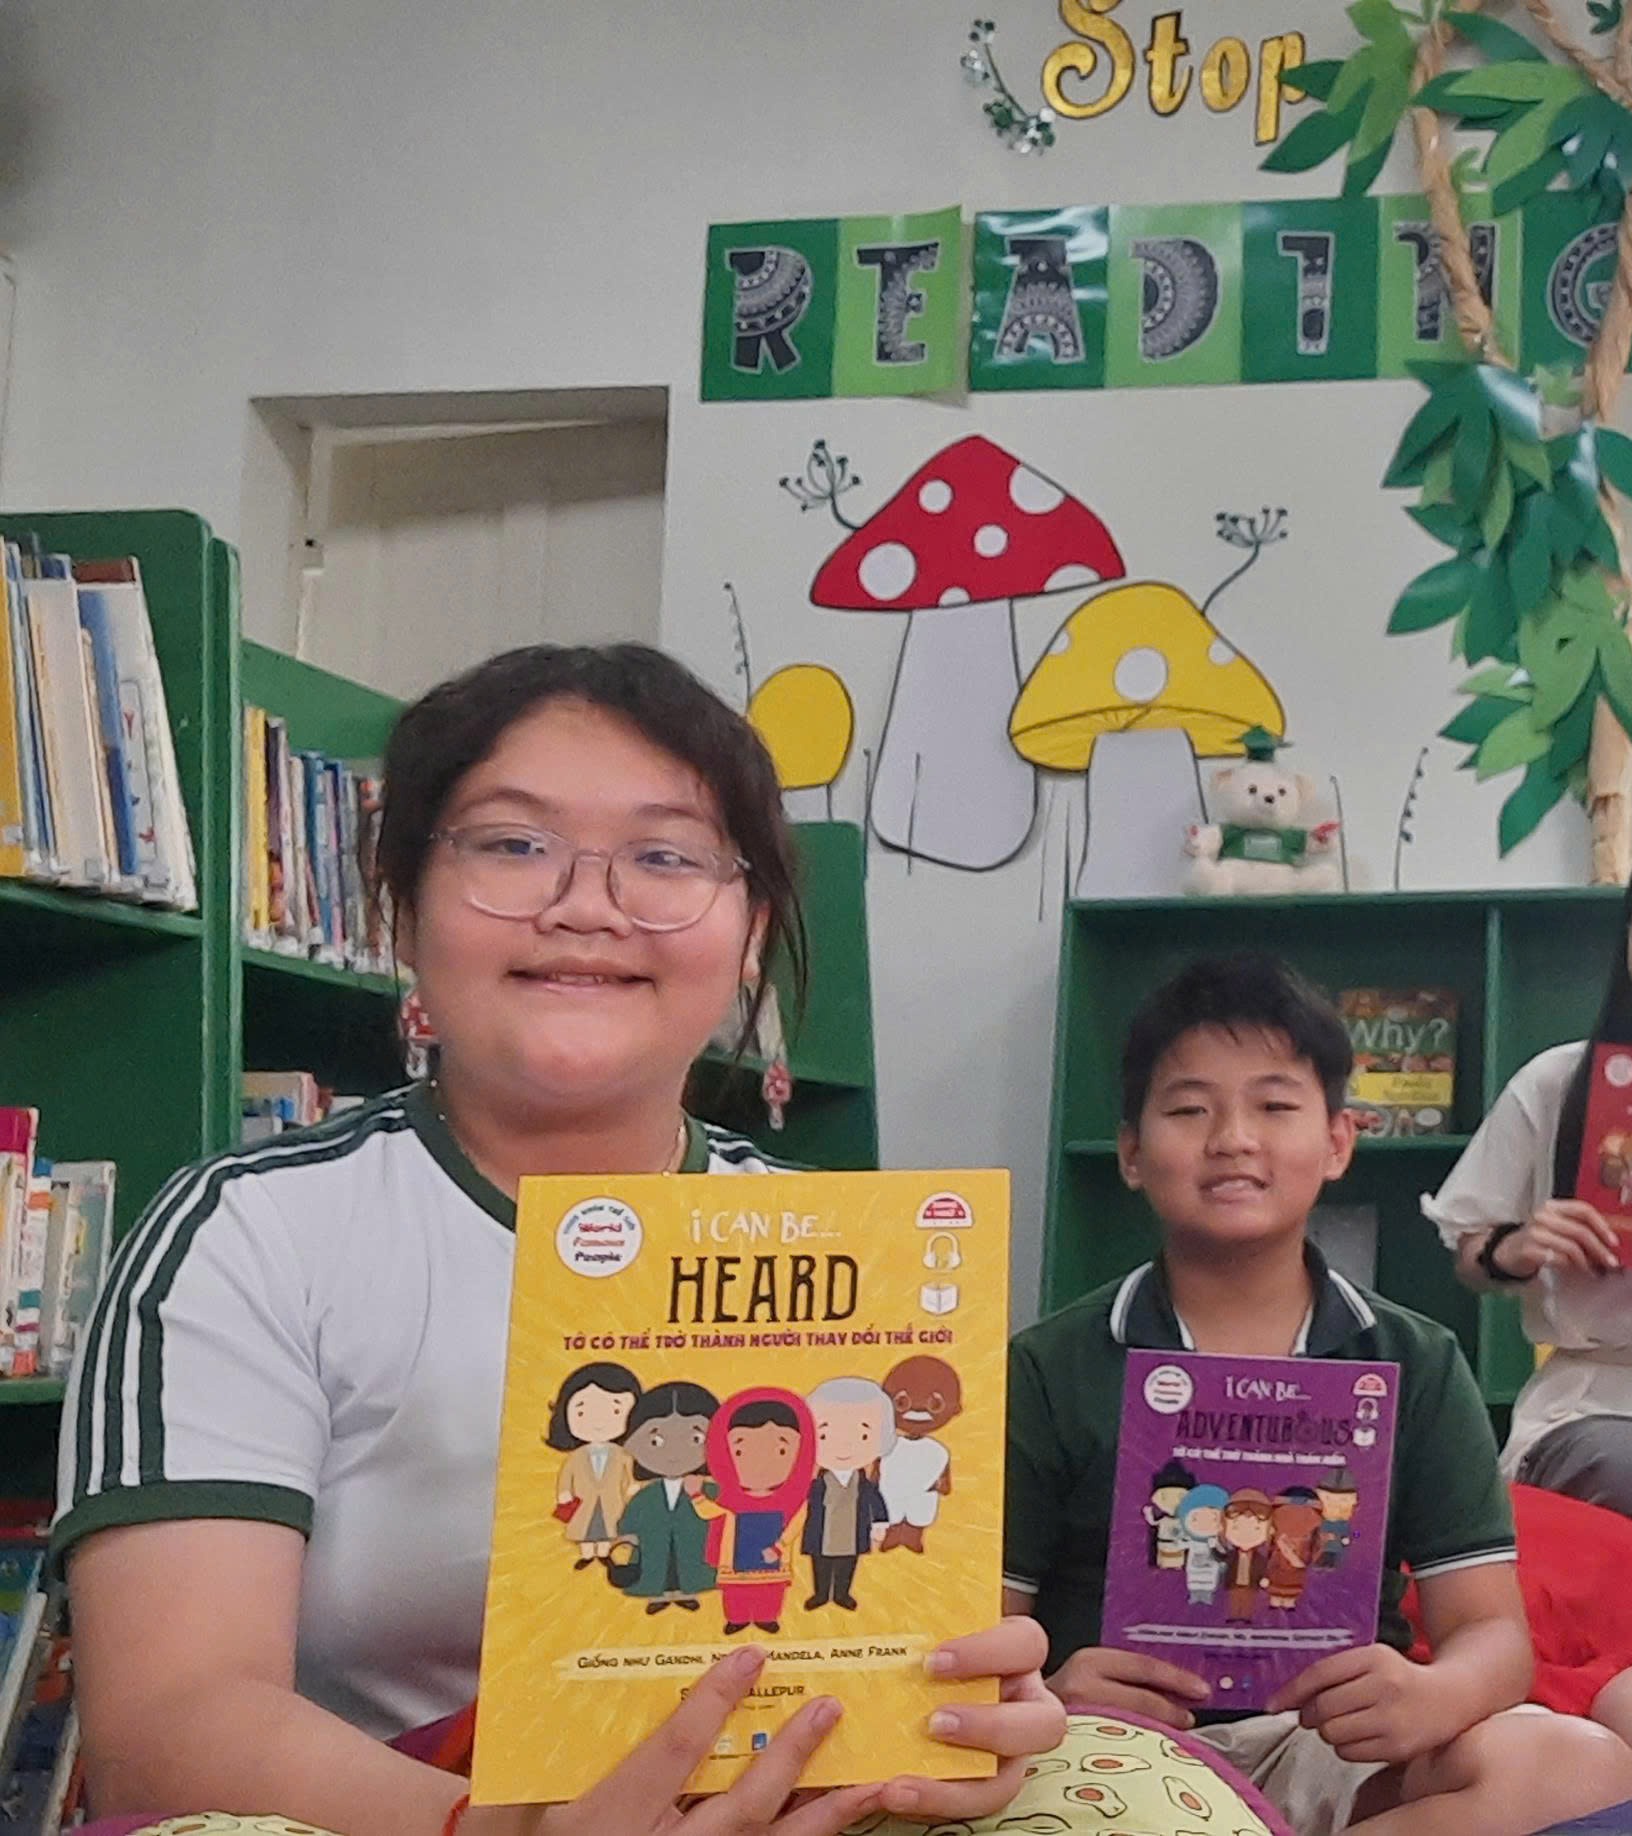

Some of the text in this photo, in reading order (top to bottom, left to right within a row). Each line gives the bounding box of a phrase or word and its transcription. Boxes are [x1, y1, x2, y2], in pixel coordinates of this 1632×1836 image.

[1041, 0, 1306, 146] Stop
[728, 219, 1622, 374] READING
[1340, 1016, 1449, 1055] Why?
[710, 1208, 770, 1243] CAN
[667, 1253, 859, 1323] HEARD
[807, 1331, 848, 1346] THAY
